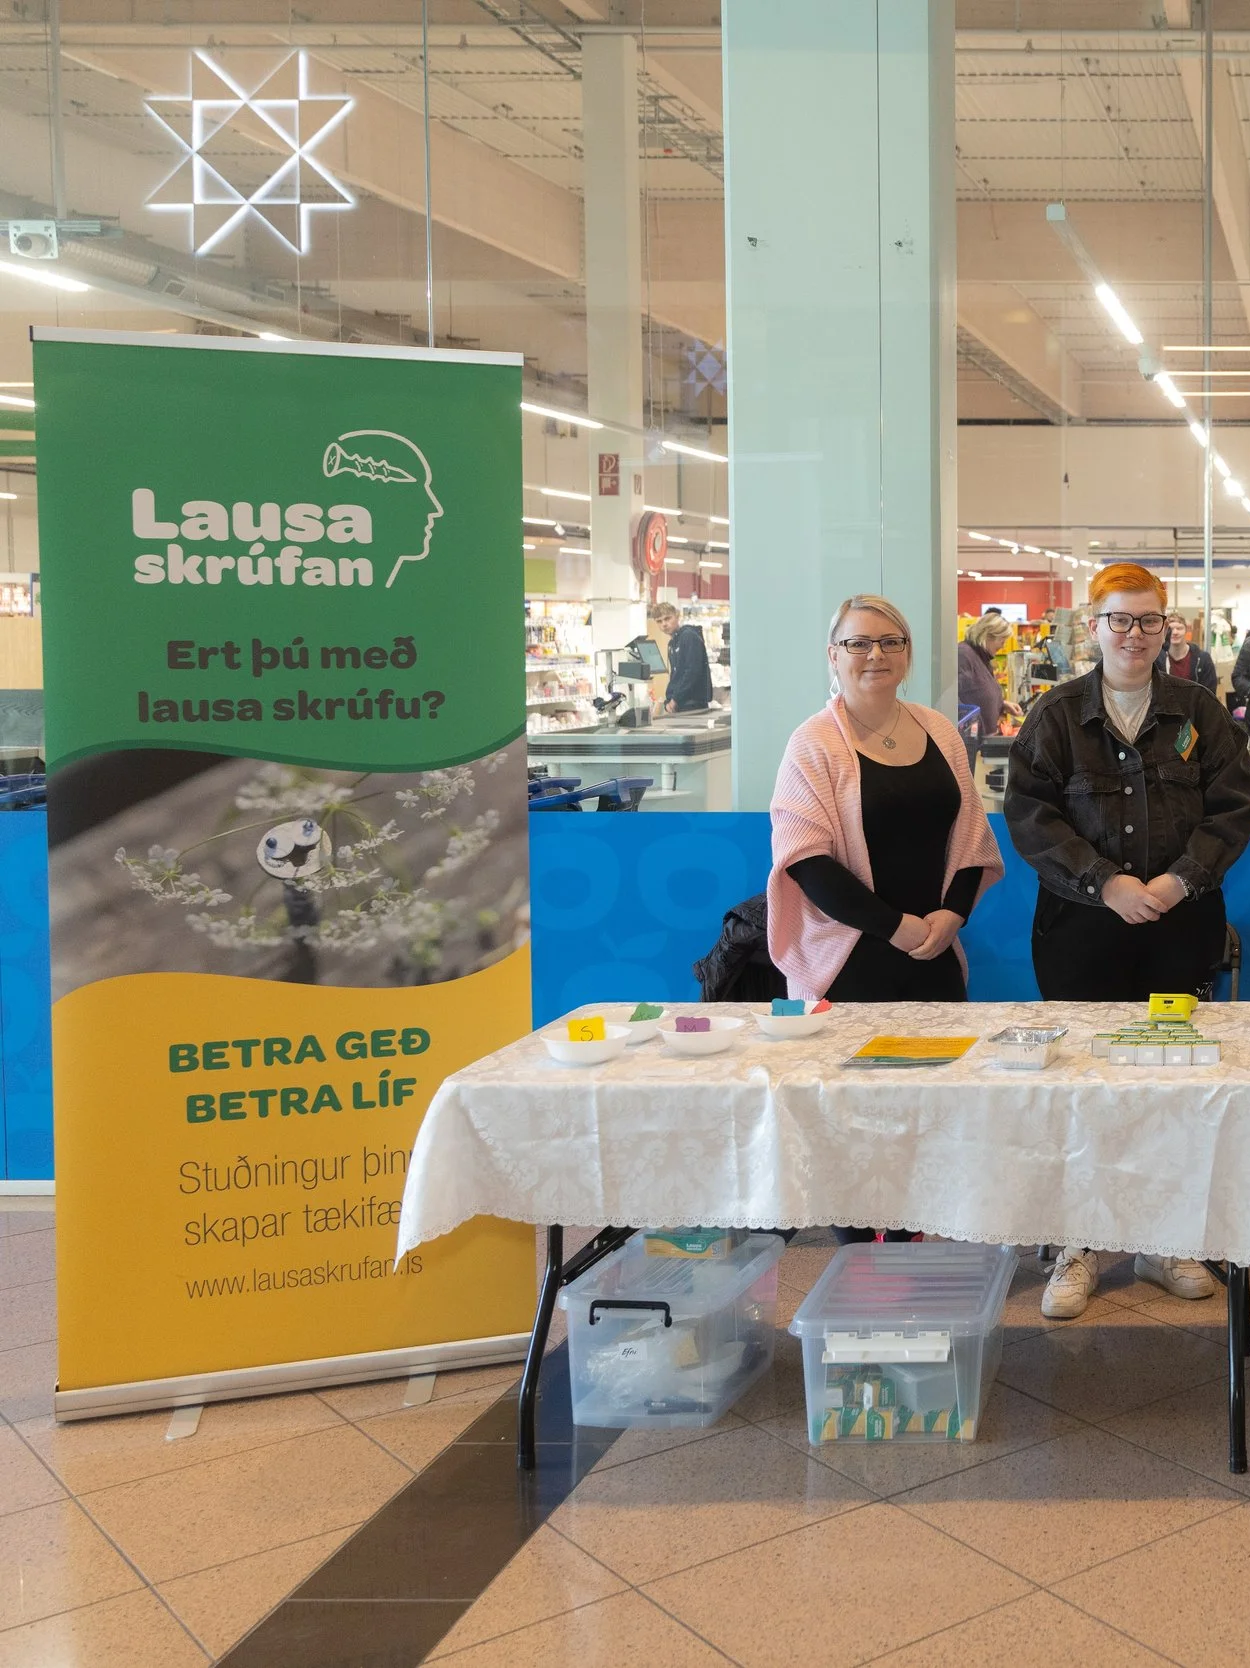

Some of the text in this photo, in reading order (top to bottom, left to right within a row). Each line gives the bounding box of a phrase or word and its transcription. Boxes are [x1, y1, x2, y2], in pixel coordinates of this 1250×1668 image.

[132, 488, 373, 544] Lausa
[133, 542, 374, 587] skrúfan
[167, 635, 417, 678] Ert þú með
[138, 688, 446, 723] lausa skrúfu?
[168, 1027, 431, 1073] BETRA GEÐ
[186, 1069, 417, 1124] BETRA LÍF
[179, 1144, 413, 1195] Stuðningur þin
[184, 1195, 402, 1248] skapar tækifæ
[186, 1251, 423, 1300] www.lausaskrufan.is
